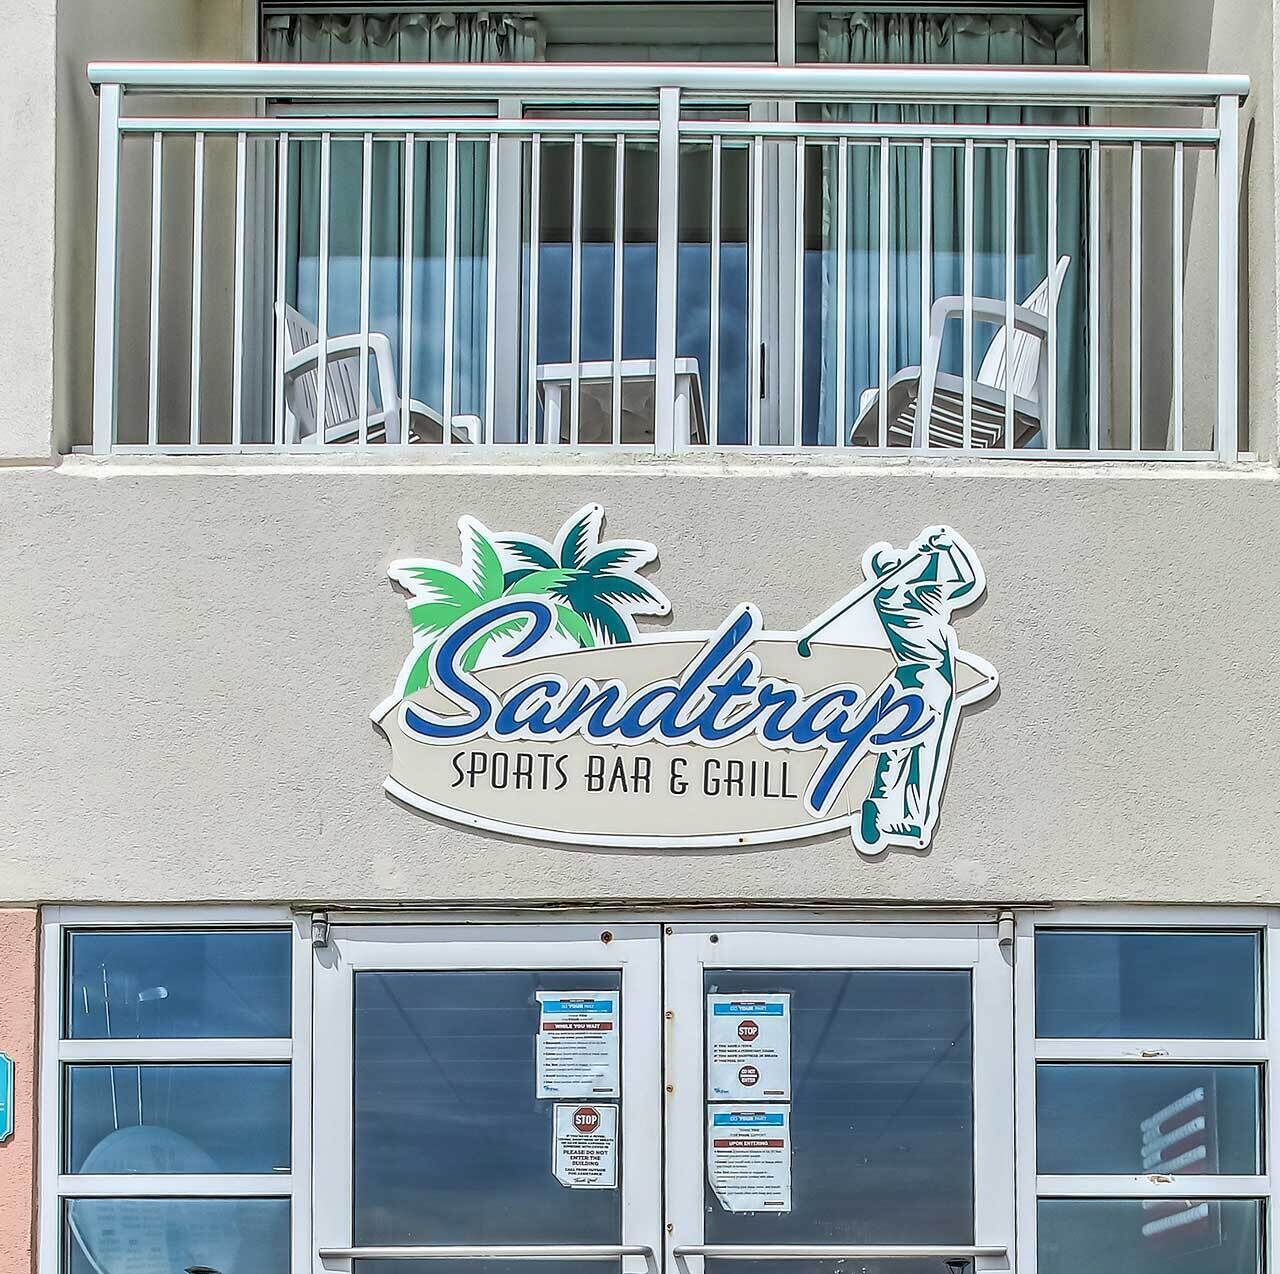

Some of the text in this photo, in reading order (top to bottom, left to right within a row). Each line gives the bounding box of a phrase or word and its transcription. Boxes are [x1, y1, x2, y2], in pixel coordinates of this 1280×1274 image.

[405, 602, 935, 811] Sandtrap
[451, 751, 798, 799] SPORTS BAR & GRILL
[739, 1027, 757, 1035] STOP
[576, 1115, 597, 1125] STOP
